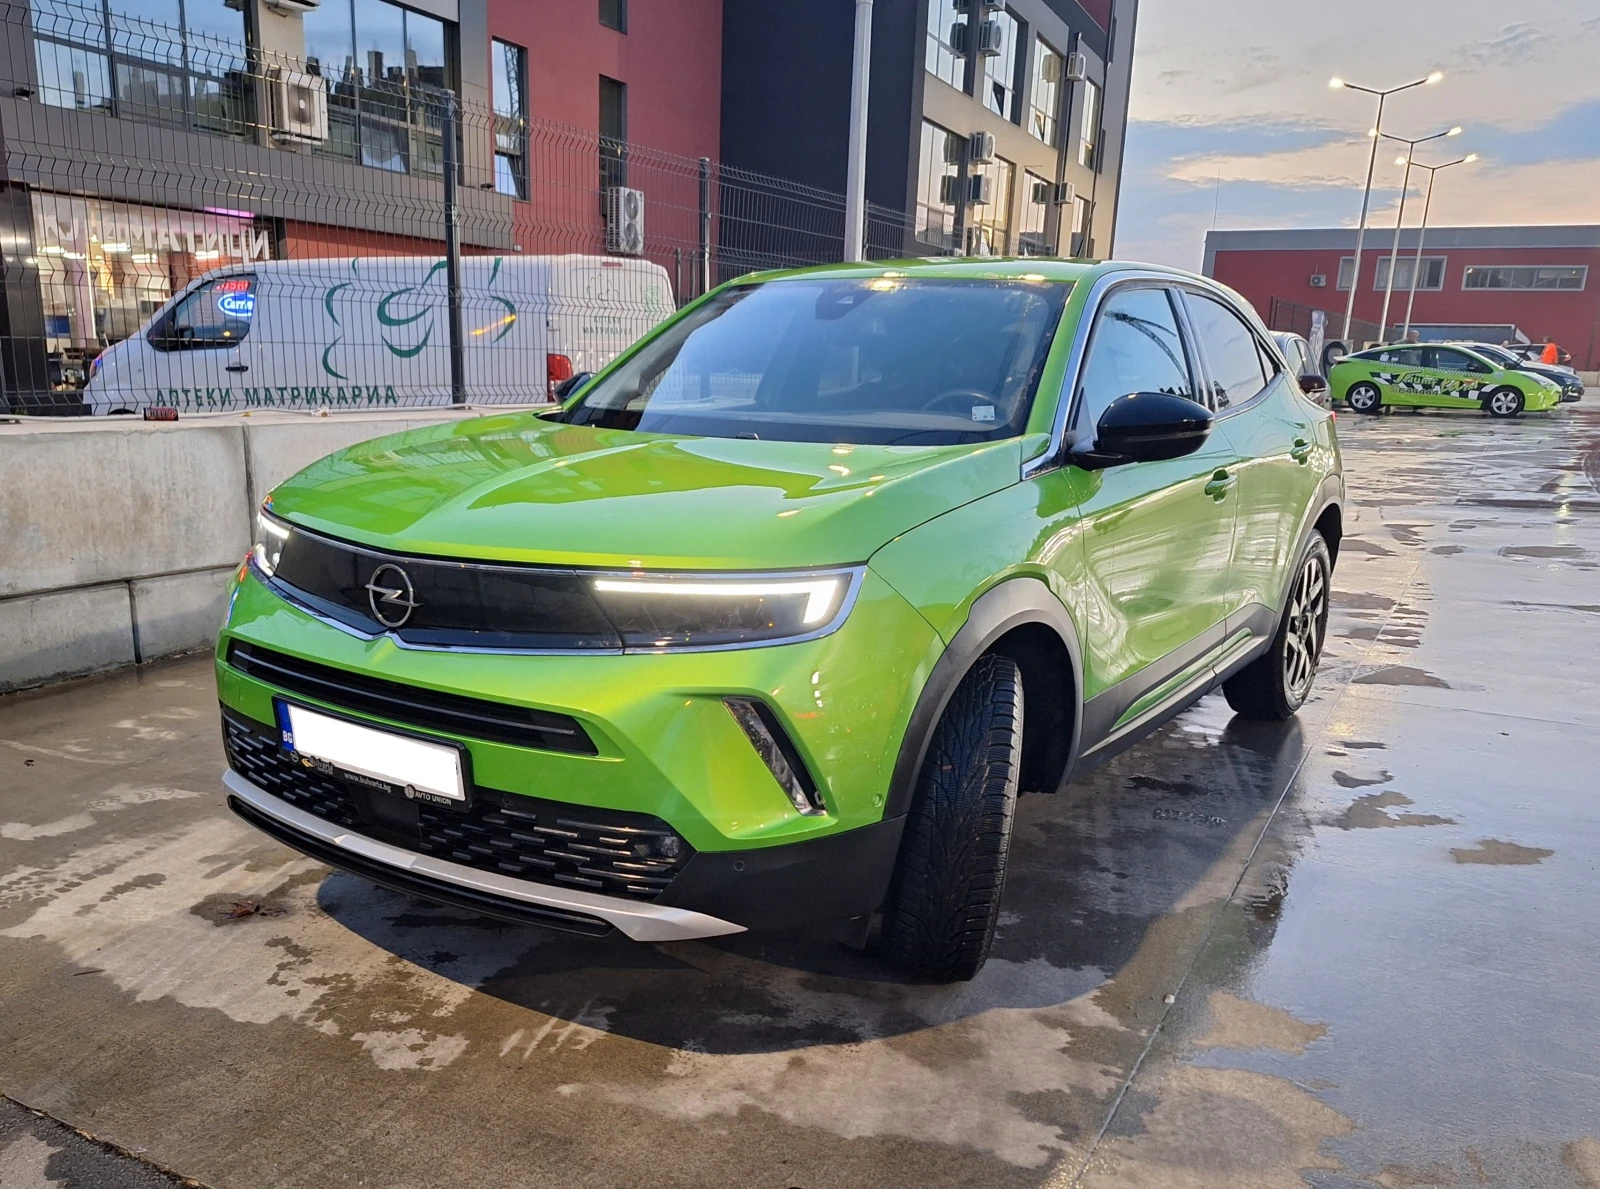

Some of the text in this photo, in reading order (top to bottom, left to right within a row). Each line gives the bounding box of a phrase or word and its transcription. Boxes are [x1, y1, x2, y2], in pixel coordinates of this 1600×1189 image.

[156, 384, 398, 407] АПТЕКИ МАТРИКАРИА
[283, 730, 293, 744] BG
[343, 772, 392, 793] www.bulvaria.bg
[431, 795, 452, 806] UNION
